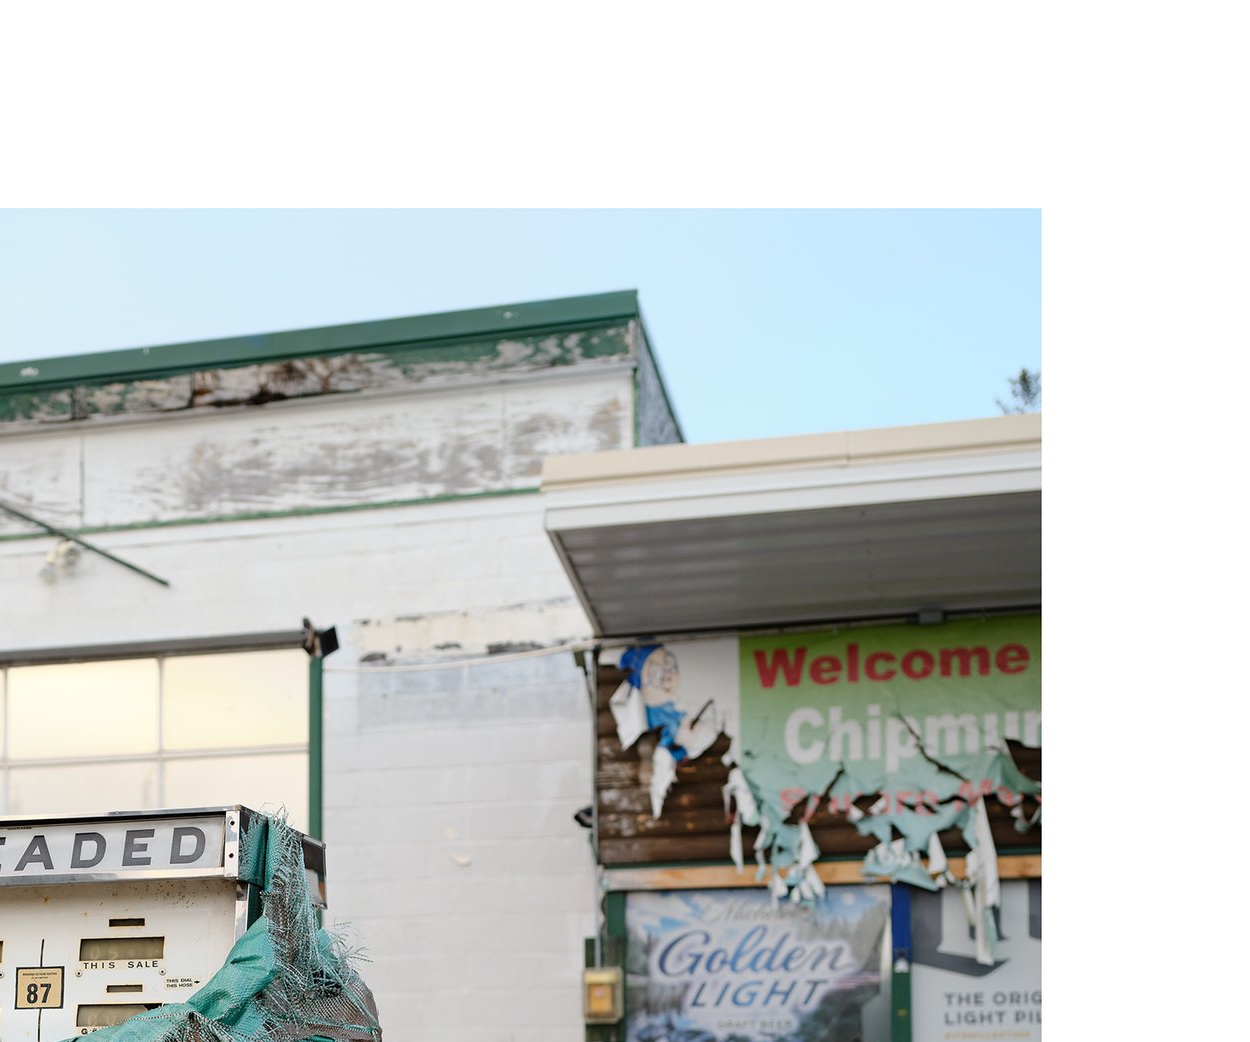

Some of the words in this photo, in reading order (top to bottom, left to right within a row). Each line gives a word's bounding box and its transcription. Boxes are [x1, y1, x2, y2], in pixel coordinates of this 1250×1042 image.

[753, 642, 1031, 688] Welcome
[658, 925, 856, 977] Golden
[83, 962, 116, 970] THIS
[127, 960, 159, 969] SALE
[27, 983, 52, 1004] 87
[691, 980, 828, 1007] LIGHT
[944, 991, 985, 1006] THE
[992, 990, 1042, 1006] ORIG
[944, 1010, 1006, 1026] LIGHT
